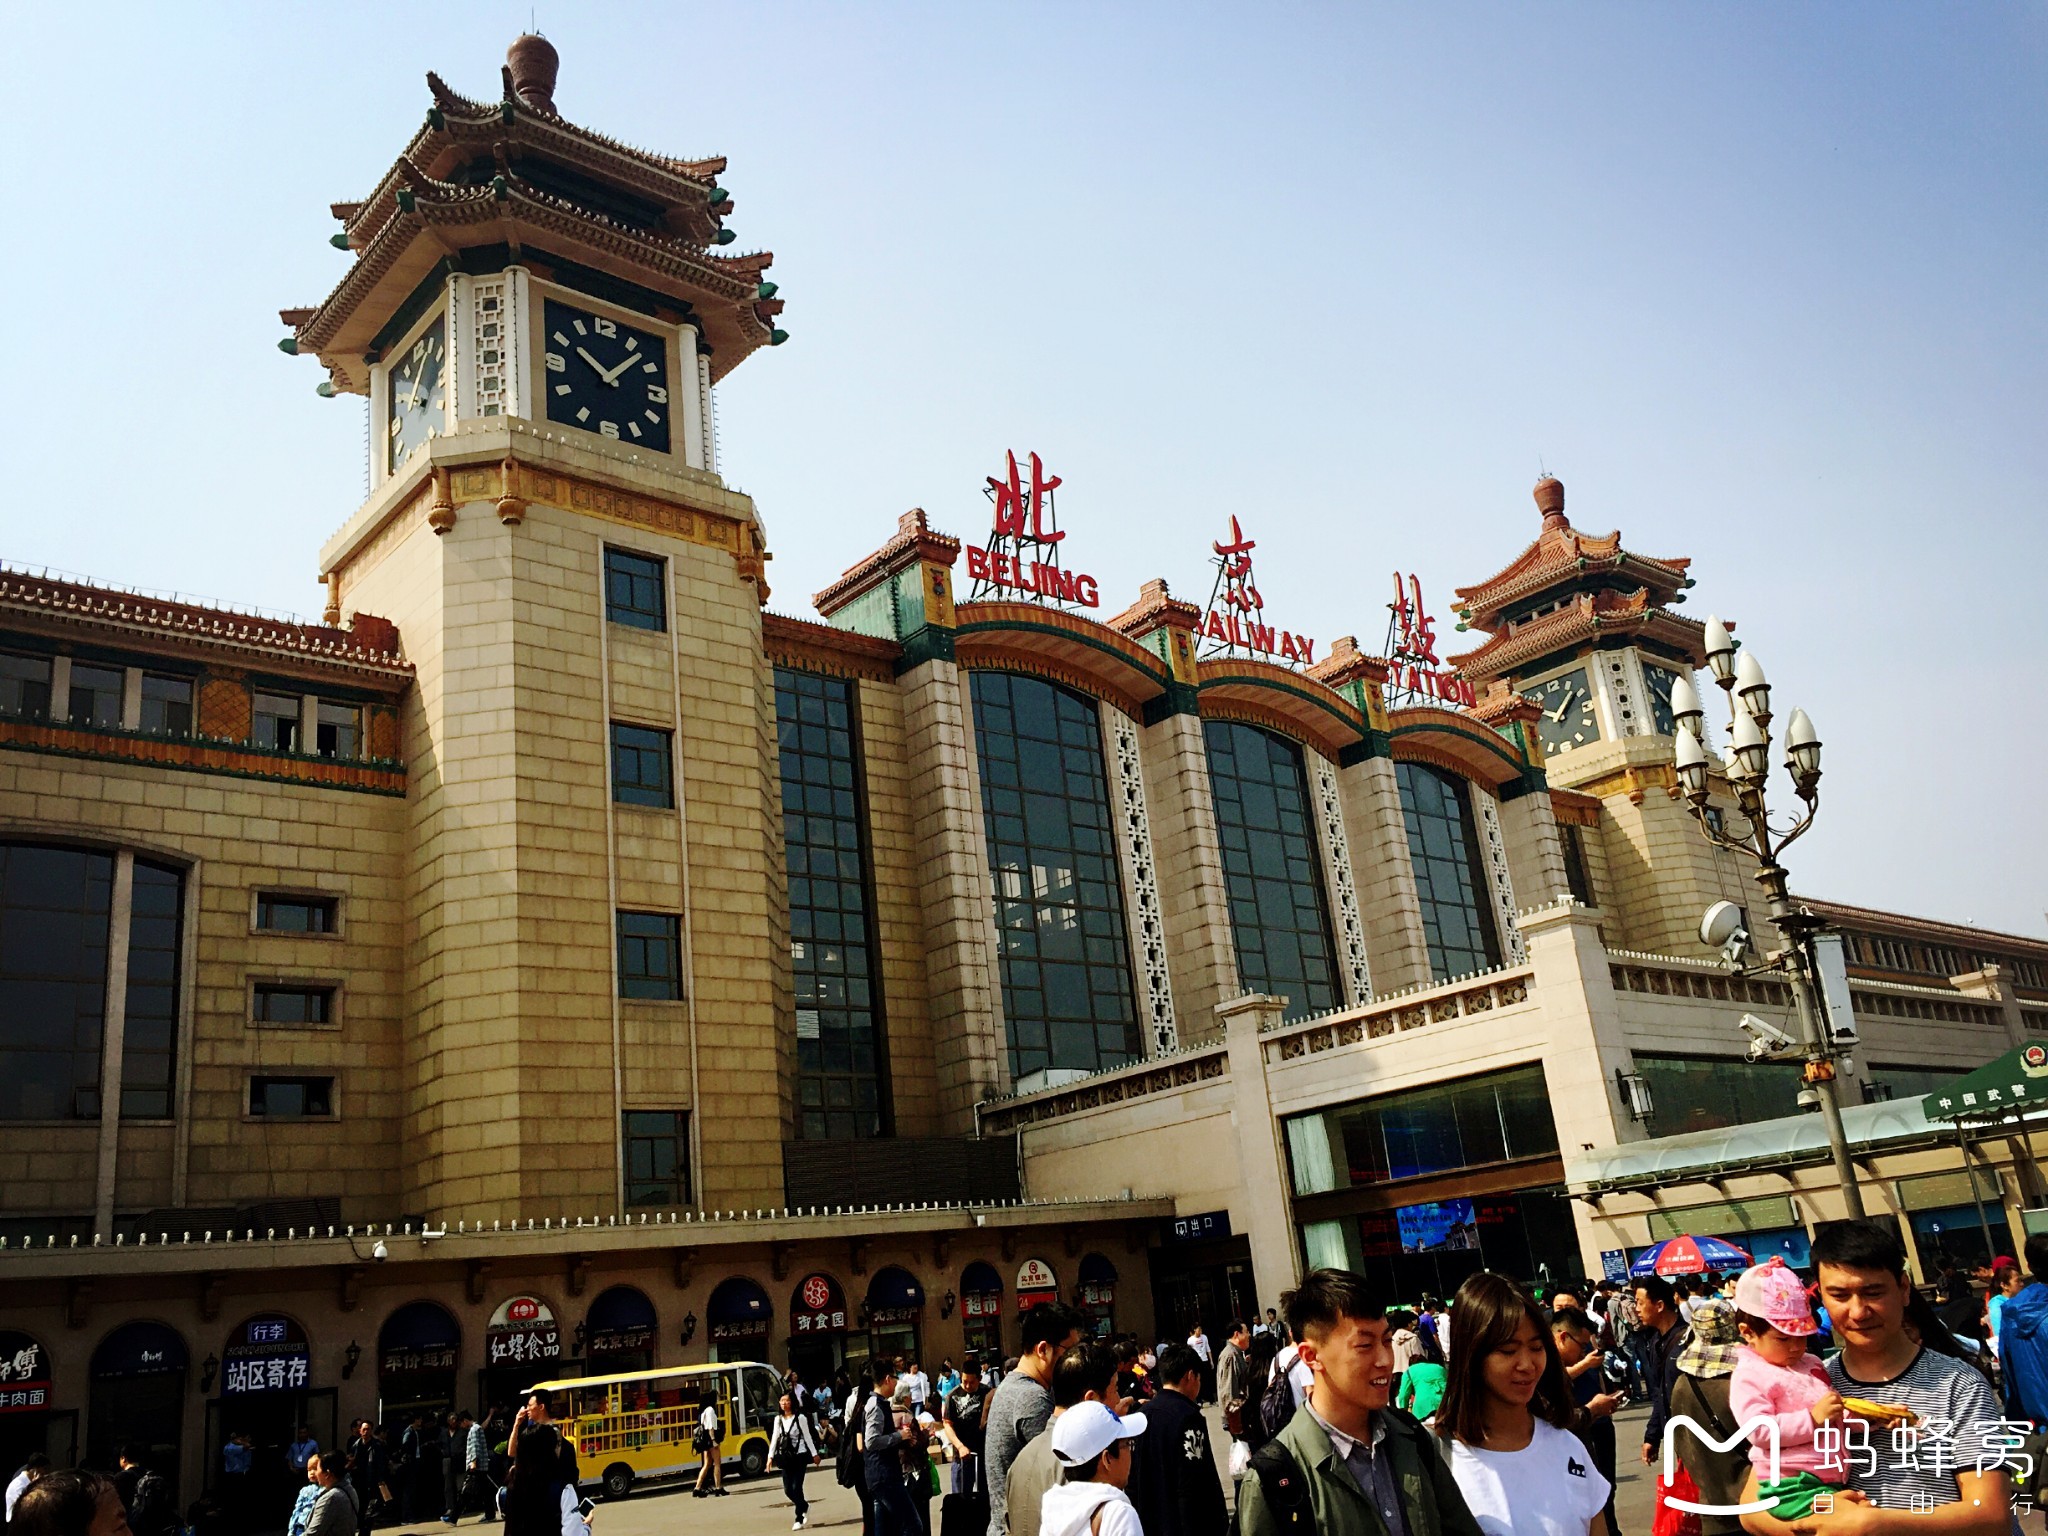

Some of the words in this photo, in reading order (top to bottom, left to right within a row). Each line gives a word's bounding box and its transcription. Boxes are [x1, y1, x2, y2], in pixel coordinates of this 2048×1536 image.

[594, 317, 617, 339] 12
[545, 352, 566, 373] 9
[647, 384, 668, 404] 3
[986, 449, 1066, 545] 北
[1213, 514, 1264, 613] 京
[966, 545, 1100, 608] BEIJING
[1546, 680, 1560, 693] 12
[1191, 1217, 1213, 1231] 出口
[1932, 1223, 1940, 1232] 5
[965, 1292, 998, 1315] 超市
[1018, 1297, 1029, 1308] 24
[797, 1312, 845, 1330] 御食园
[253, 1324, 284, 1341] 行李
[593, 1332, 651, 1350] 北京特产
[490, 1331, 560, 1364] 红螺食品
[384, 1349, 456, 1373] 平价超市
[227, 1356, 308, 1393] 站区寄存
[0, 1389, 45, 1408] 牛肉面
